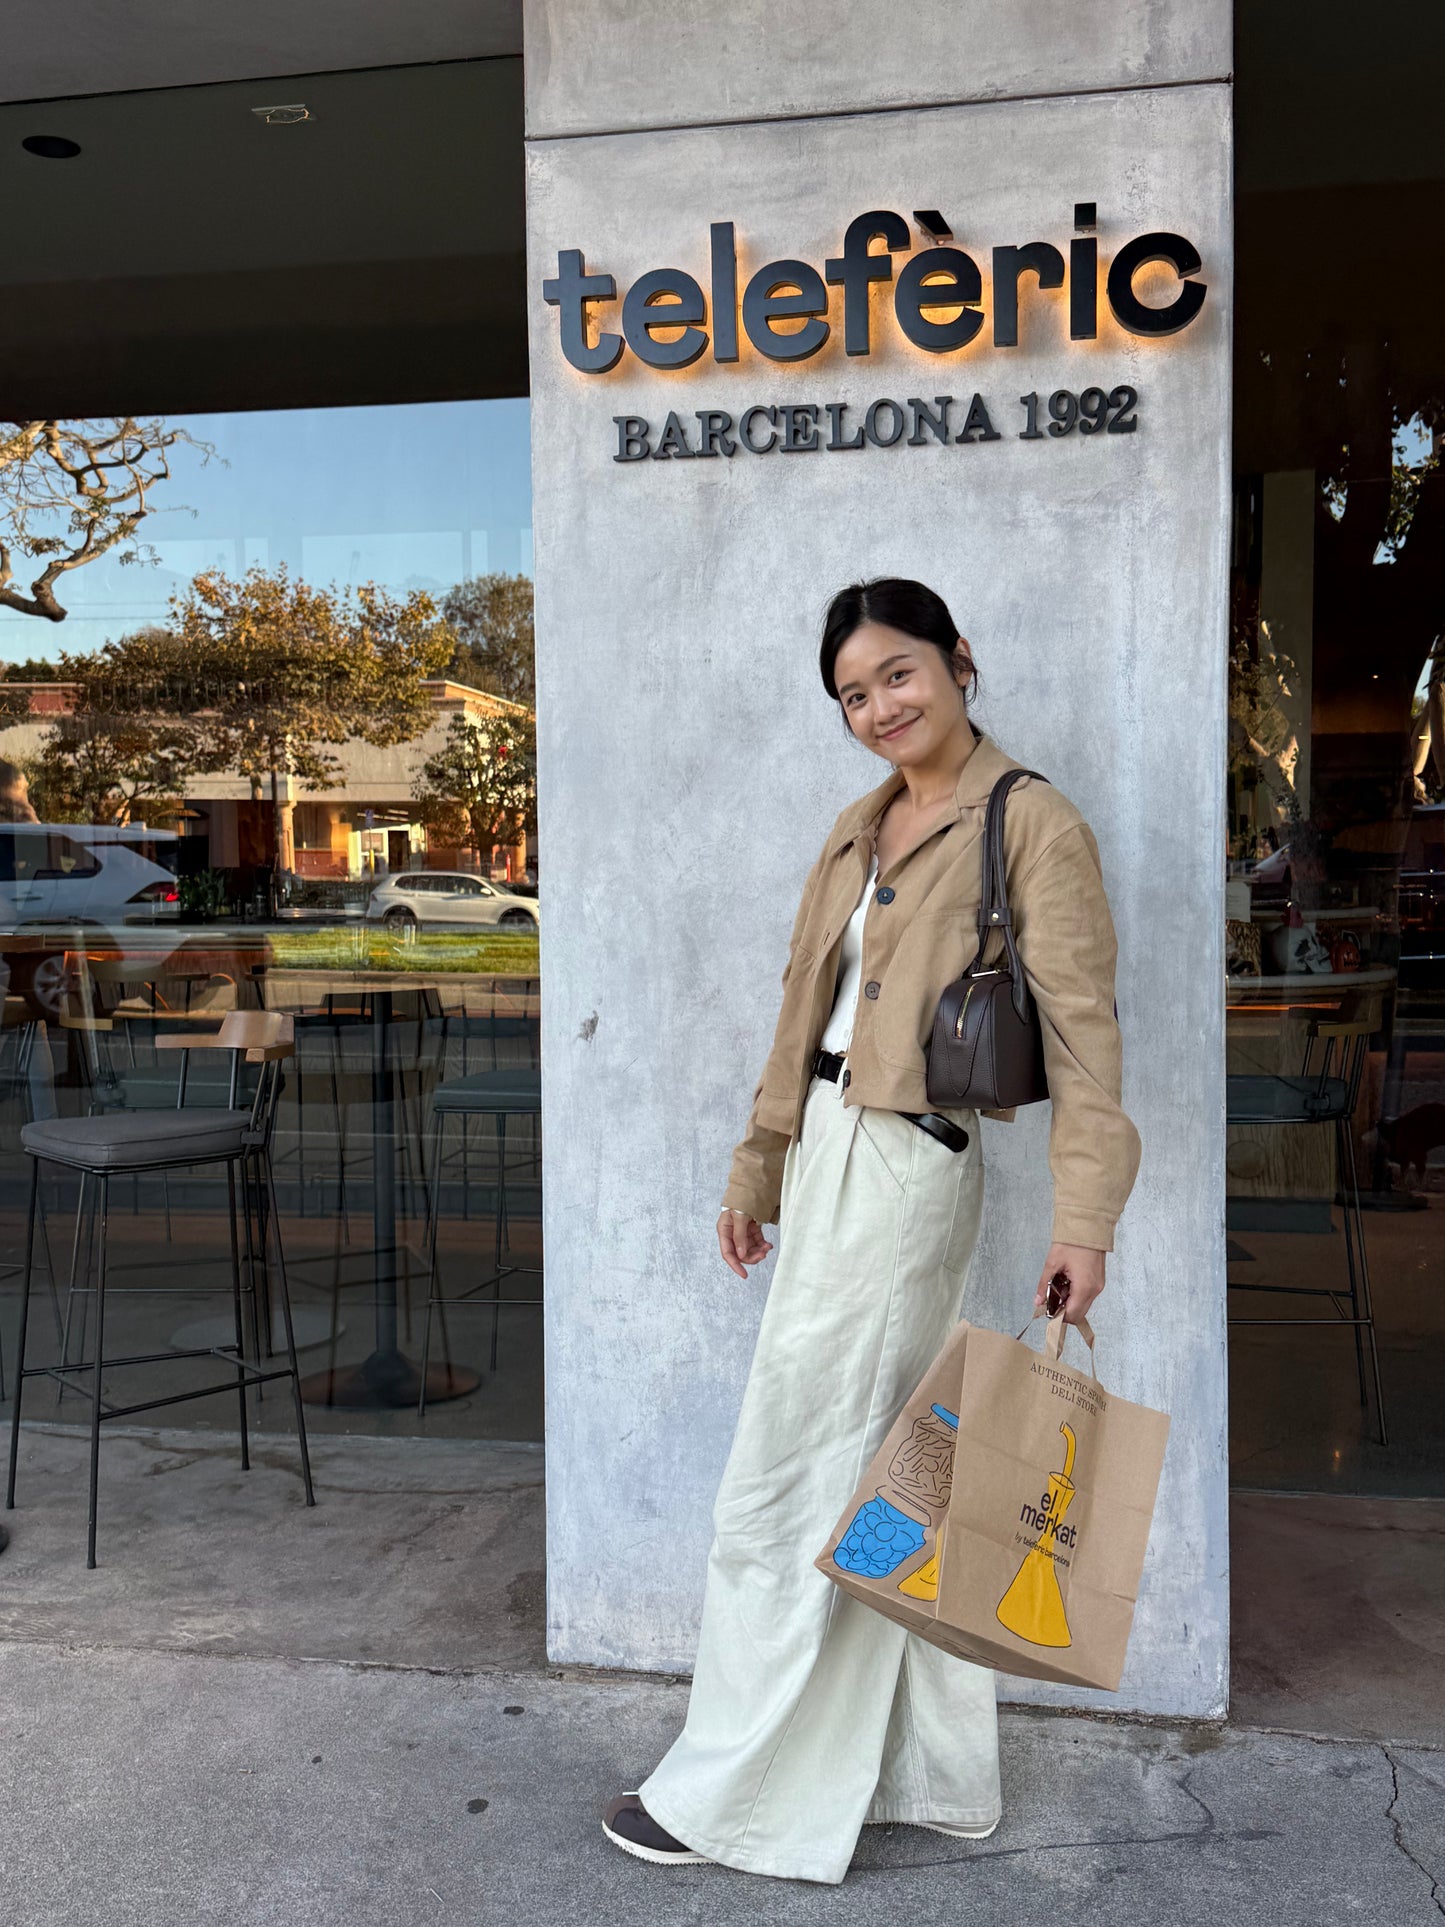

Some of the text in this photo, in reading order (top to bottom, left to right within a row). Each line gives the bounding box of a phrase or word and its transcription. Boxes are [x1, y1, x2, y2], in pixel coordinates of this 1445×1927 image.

[543, 202, 1208, 374] telefèric
[612, 384, 1139, 462] BARCELONA 1992
[1030, 1362, 1088, 1395] AUTHENTIC
[1051, 1385, 1075, 1403] DELI
[1041, 1489, 1058, 1514] el
[1020, 1503, 1077, 1549] merkat
